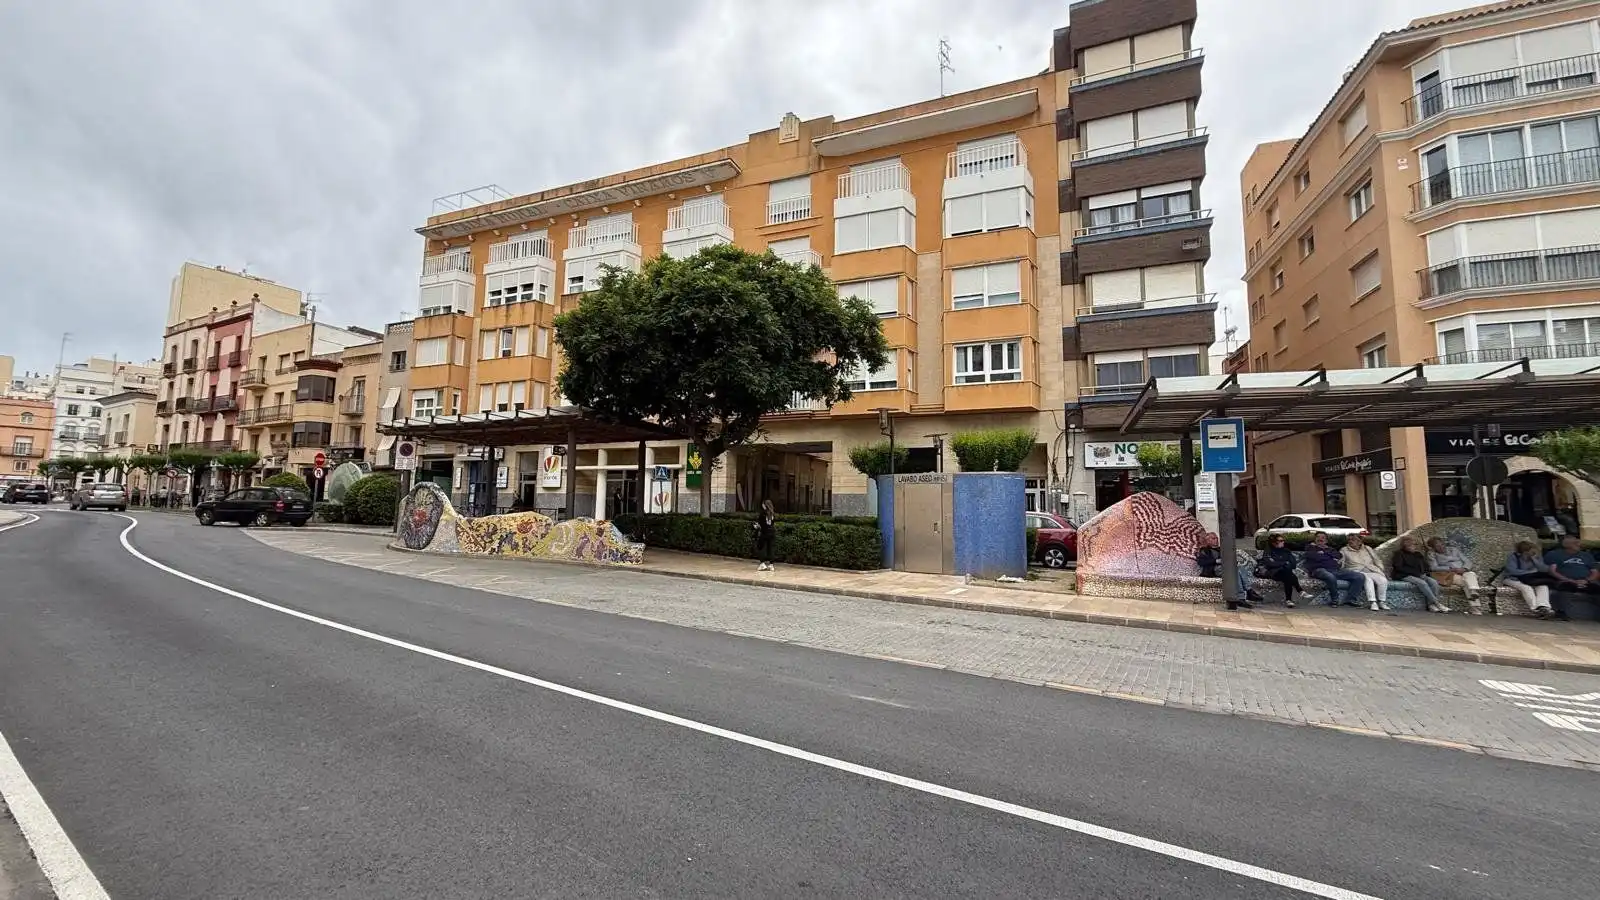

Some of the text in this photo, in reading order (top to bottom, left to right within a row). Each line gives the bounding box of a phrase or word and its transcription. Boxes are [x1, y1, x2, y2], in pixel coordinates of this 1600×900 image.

[1449, 438, 1500, 447] VIAES
[898, 475, 918, 483] LAVABO
[918, 474, 932, 483] ASEO
